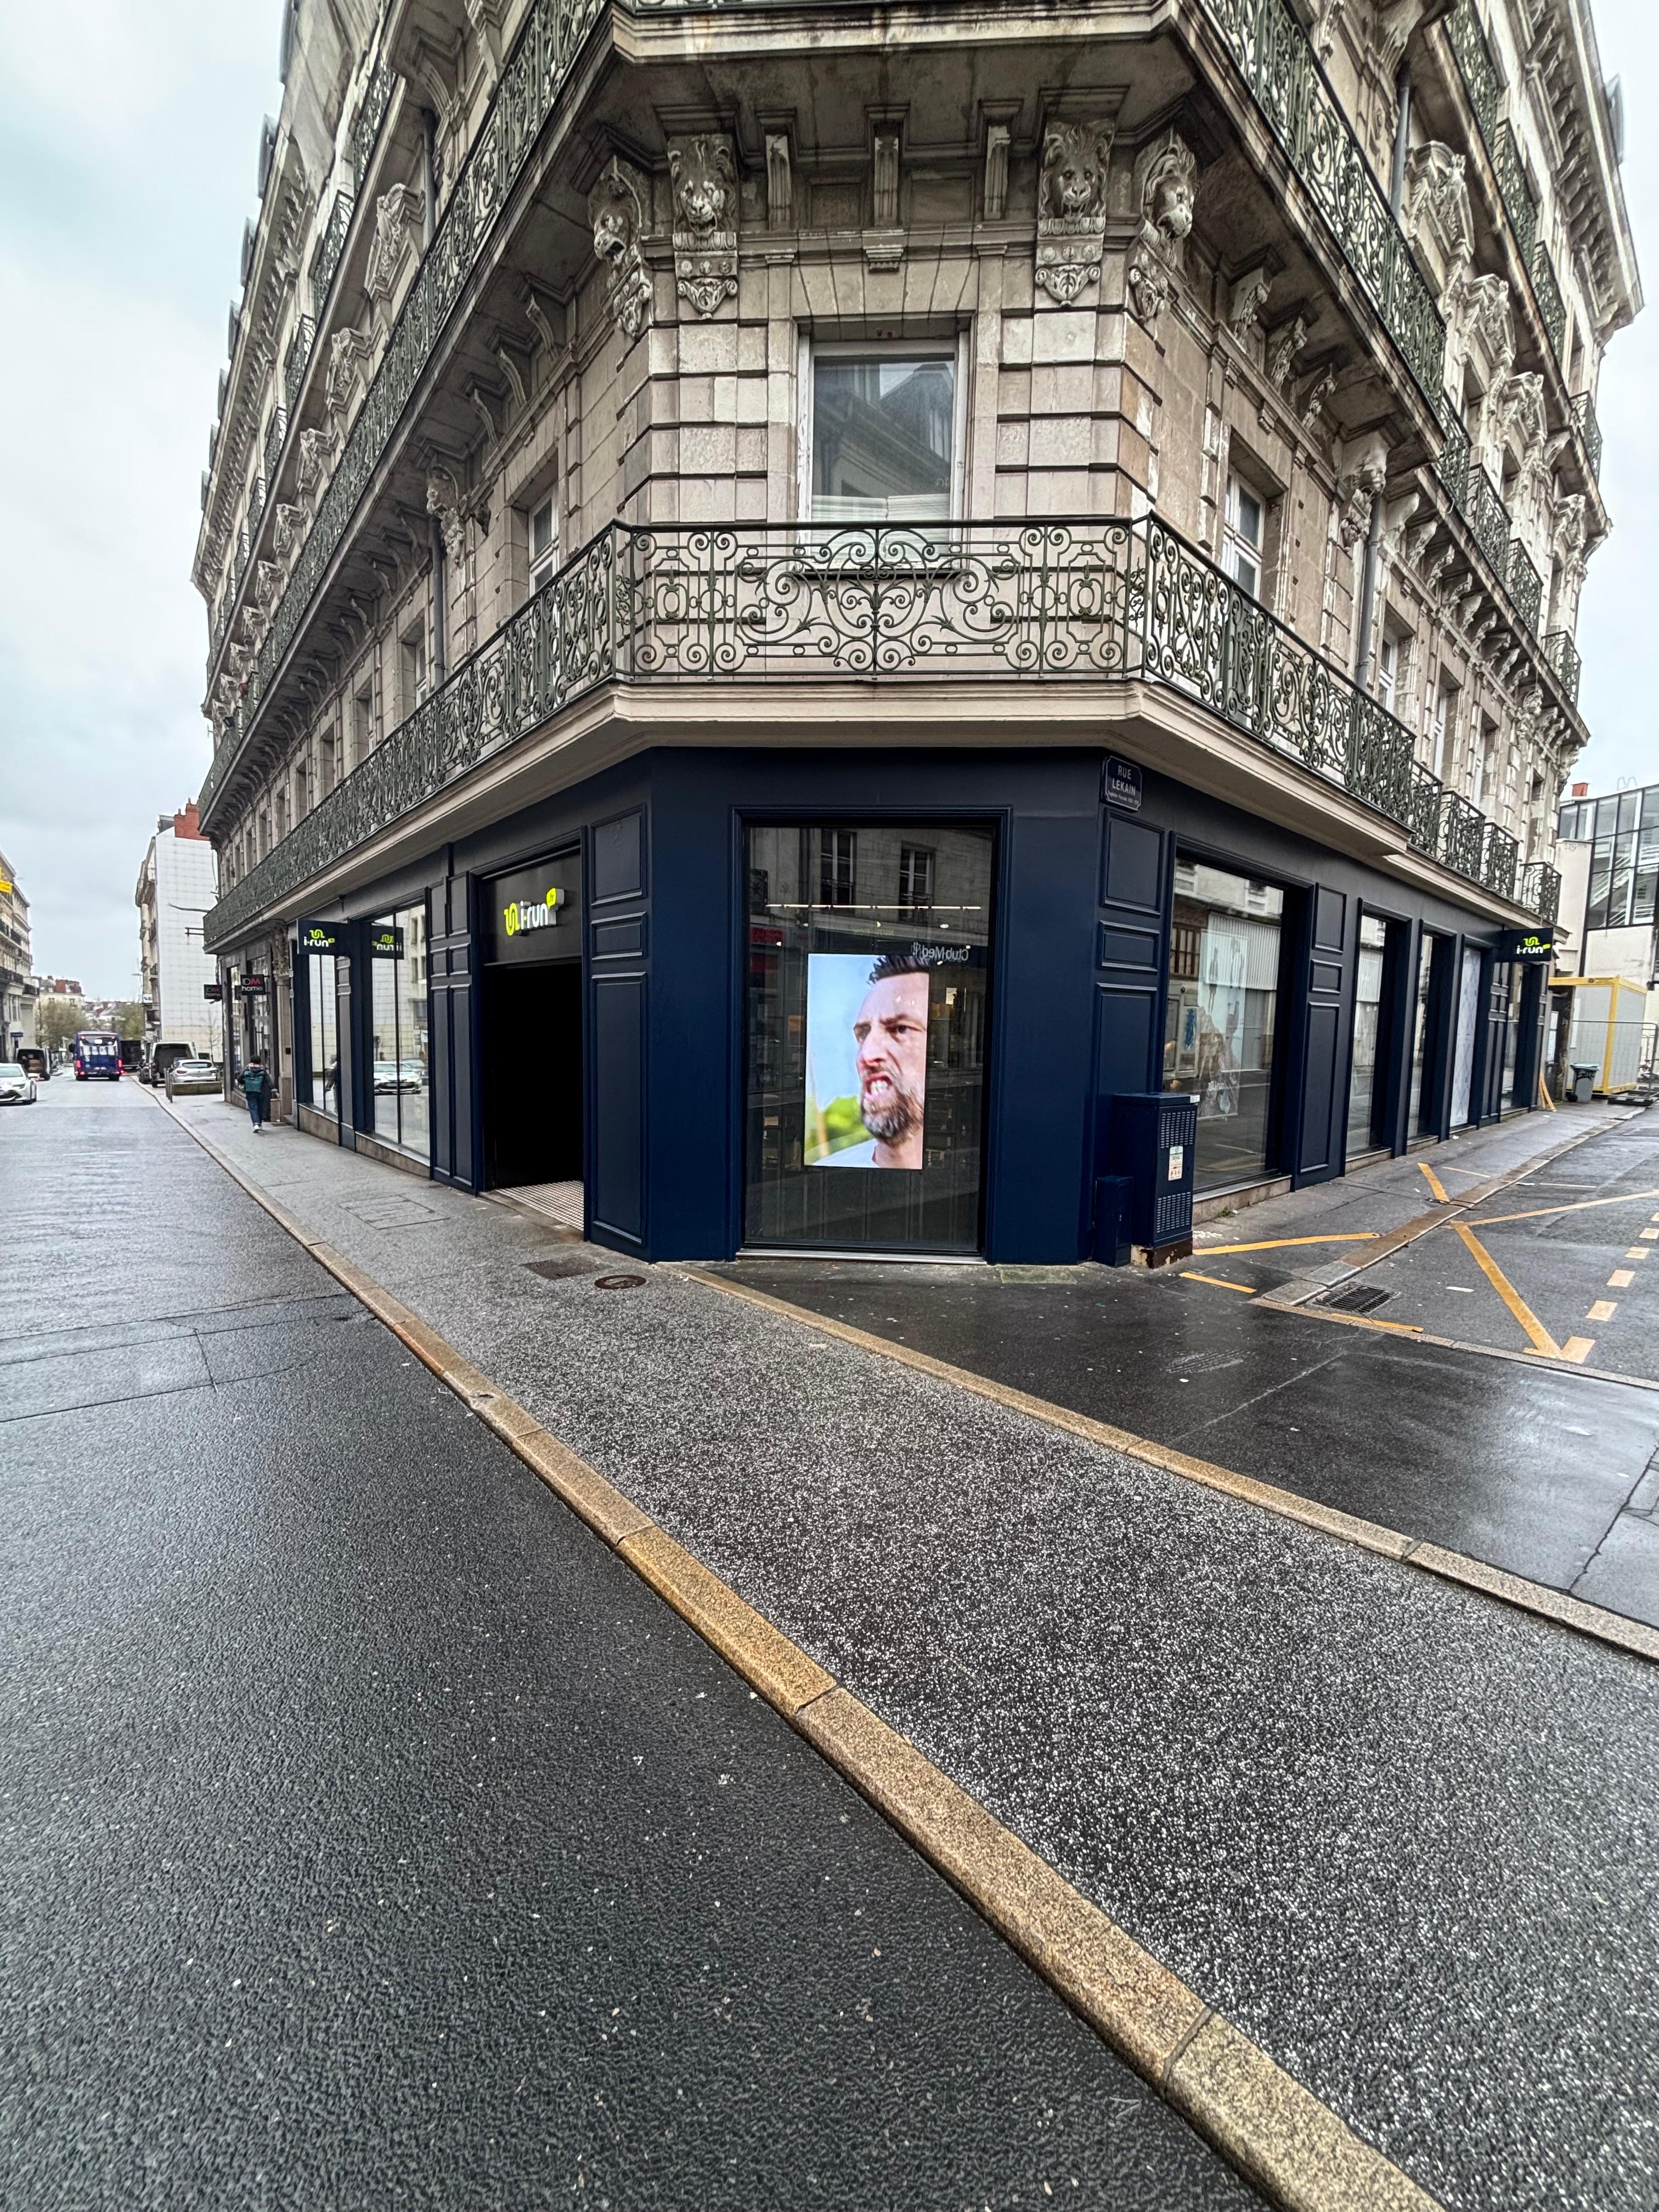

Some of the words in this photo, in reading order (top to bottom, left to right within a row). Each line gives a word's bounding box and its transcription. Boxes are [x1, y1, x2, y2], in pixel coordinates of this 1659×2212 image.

[1118, 765, 1131, 780] RUE
[1112, 778, 1136, 796] LEKAIN
[1516, 945, 1543, 954] i-run
